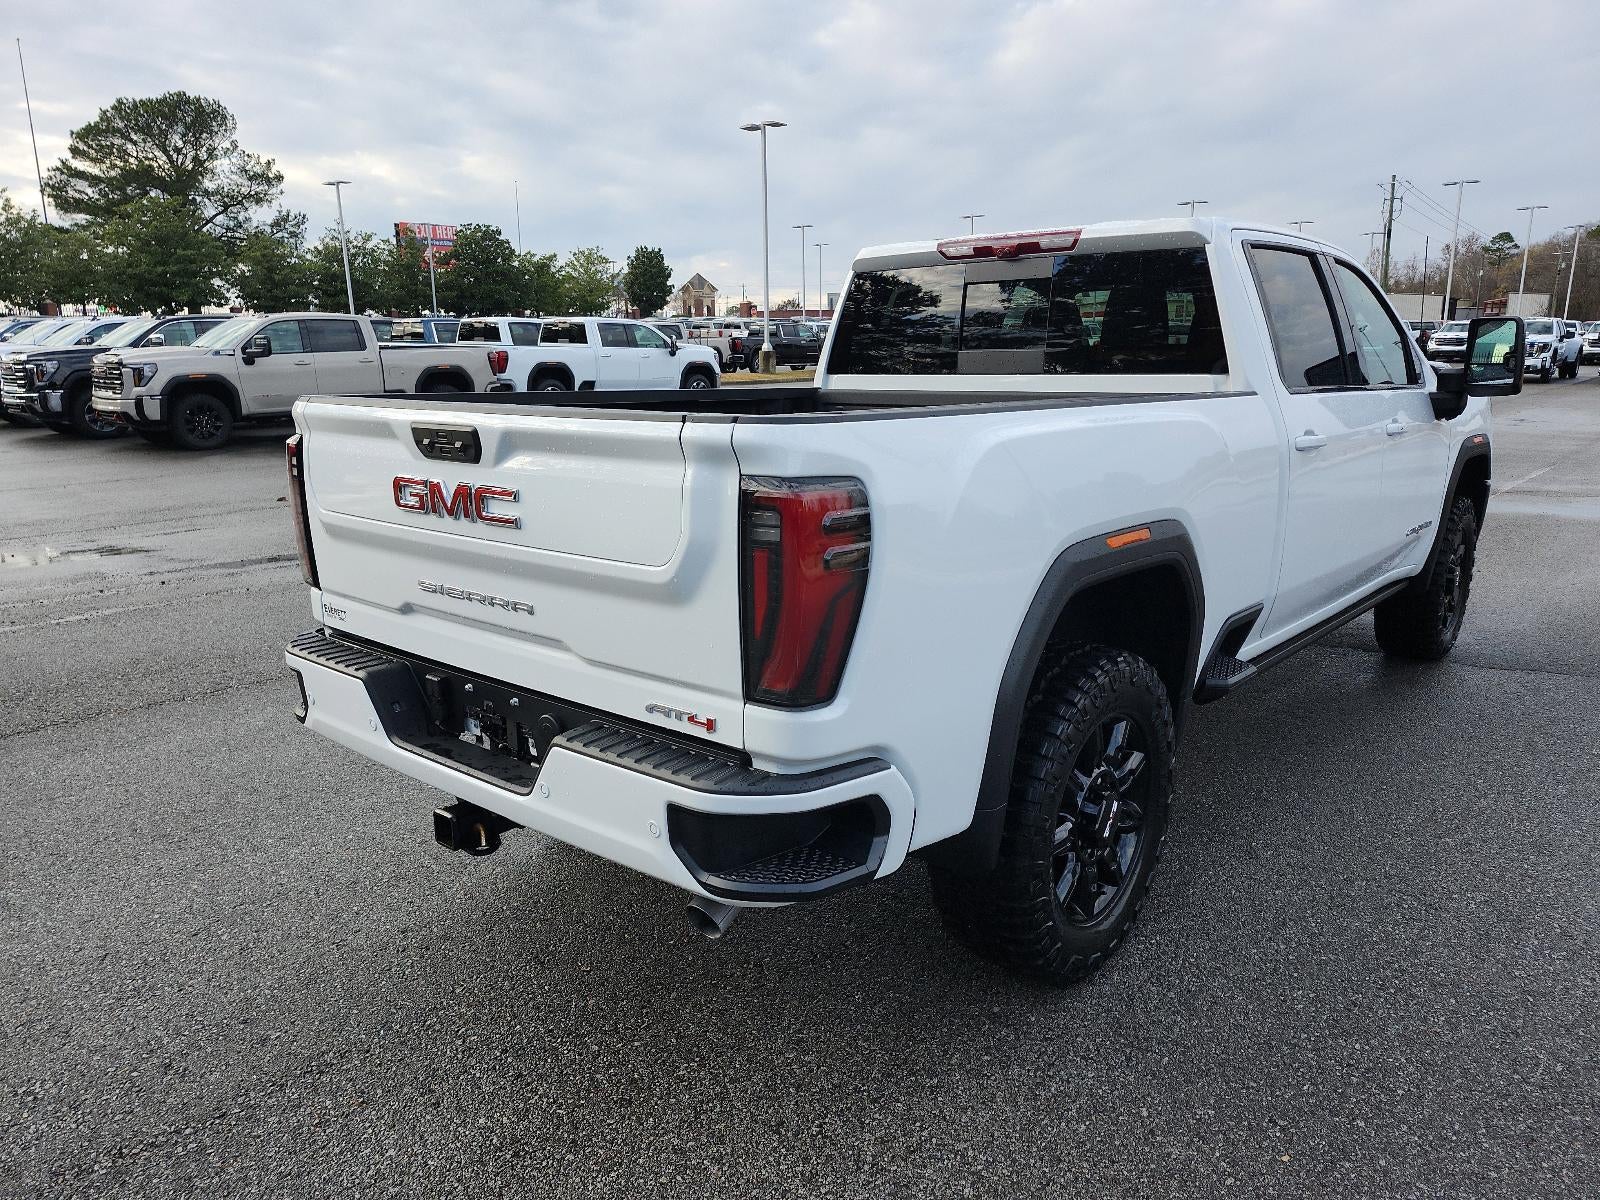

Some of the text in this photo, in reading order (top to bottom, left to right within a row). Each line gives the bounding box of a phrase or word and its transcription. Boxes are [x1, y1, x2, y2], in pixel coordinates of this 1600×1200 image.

[393, 474, 521, 529] GMC
[323, 603, 347, 617] EVERETT
[418, 579, 535, 615] SIERRA
[645, 703, 717, 733] AT4
